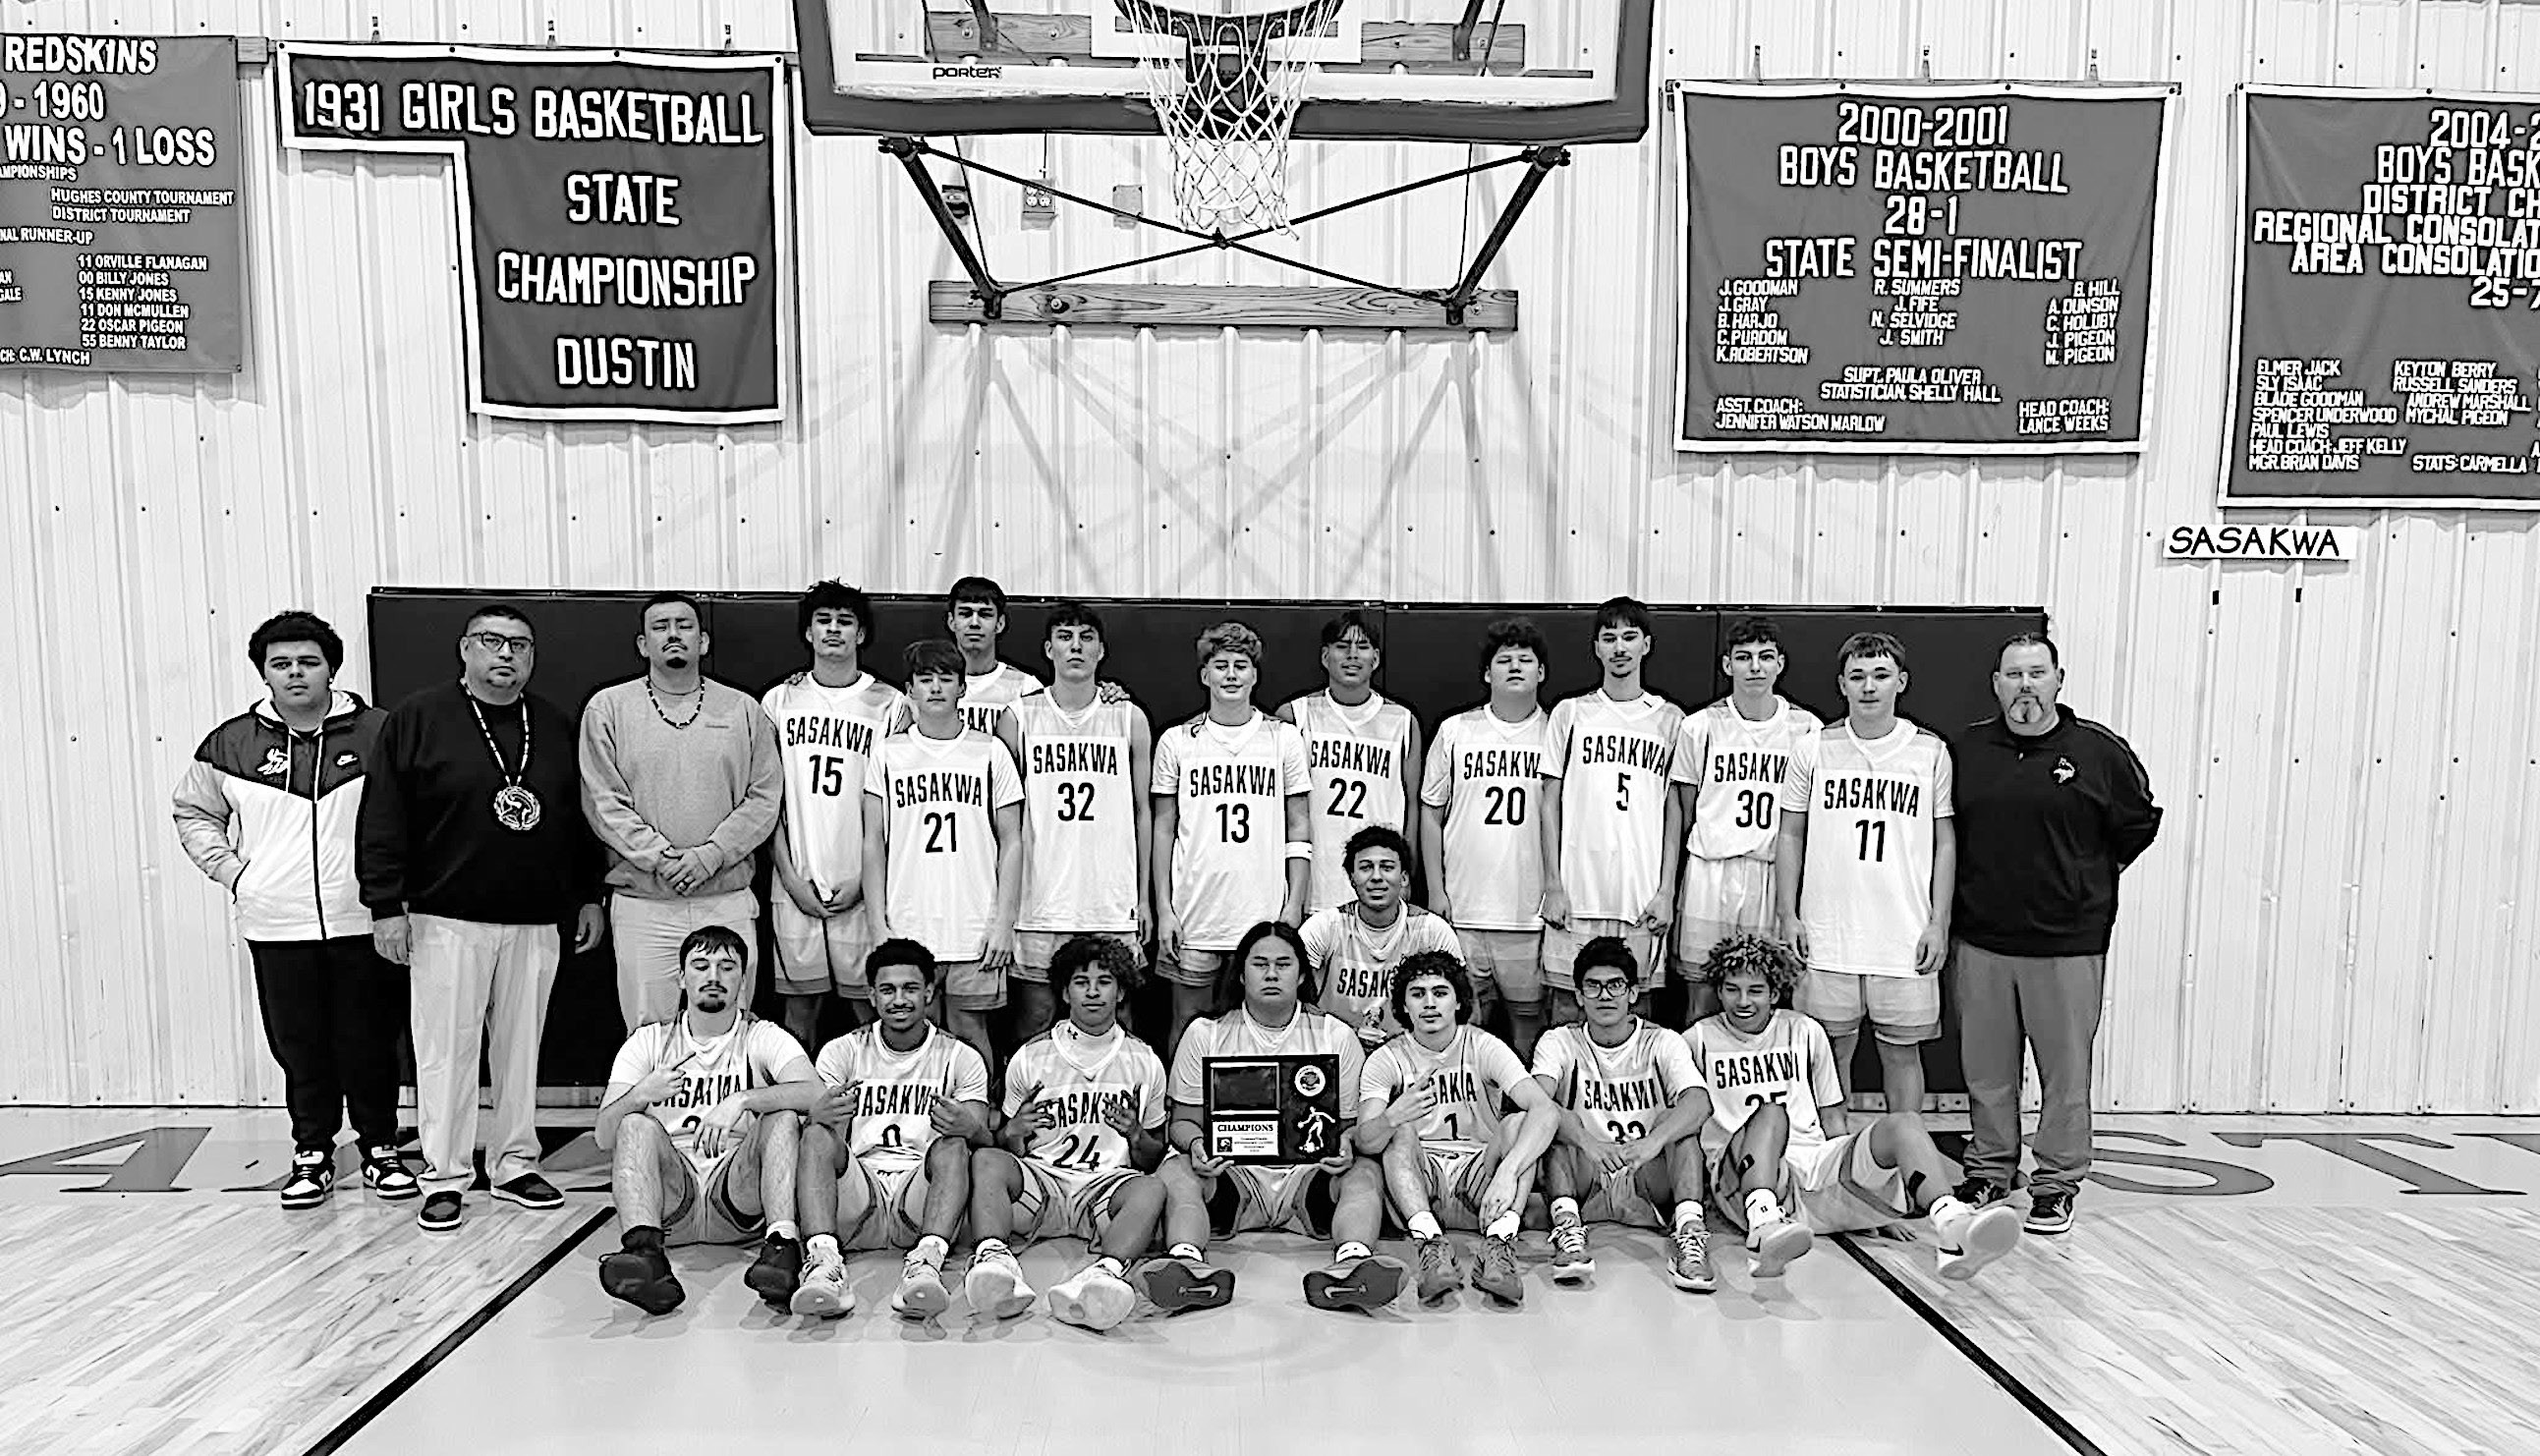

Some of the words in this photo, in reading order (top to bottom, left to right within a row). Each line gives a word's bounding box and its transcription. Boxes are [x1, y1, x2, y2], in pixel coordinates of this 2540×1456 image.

[6, 36, 156, 73] REDSKINS
[34, 82, 103, 119] 1960
[306, 82, 378, 131] 1931
[403, 83, 515, 135] GIRLS
[536, 90, 762, 142] BASKETBALL
[1839, 103, 2006, 146] 2000-2001
[5, 125, 85, 164] WINS
[113, 128, 125, 164] 1
[137, 128, 214, 165] LOSS
[1780, 146, 1856, 185] BOYS
[1875, 149, 2067, 193] BASKETBALL
[2378, 144, 2451, 184] BOYS
[2466, 147, 2540, 190] BASK
[52, 189, 101, 203] HUGHES
[104, 191, 150, 203] COUNTY
[153, 191, 233, 204] TOURNAMENT
[568, 174, 679, 224] STATE
[2364, 185, 2492, 216] DISTRICT
[2509, 188, 2540, 218] CH
[53, 206, 107, 221] DISTRICT
[110, 208, 190, 222] TOURNAMENT
[1886, 196, 1956, 235] 28-1
[21, 228, 92, 244] RUNNER-UP
[2254, 209, 2392, 245] REGIONAL
[2405, 213, 2540, 250] CONSOLAT
[79, 255, 91, 267] 11
[95, 255, 141, 268] ORVILLE
[146, 256, 206, 269] FLANAGAN
[1767, 238, 1854, 277] STATE
[1874, 239, 2081, 279] SEMI-FINALIST
[2291, 242, 2363, 273] AREA
[80, 271, 93, 284] 00
[96, 272, 127, 284] BILLY
[130, 272, 168, 286] JONES
[498, 252, 755, 306] CHAMPIONSHIP
[1875, 279, 1888, 295] R.
[1891, 279, 1960, 295] SUMMERS
[2074, 282, 2085, 297] B.
[2089, 279, 2119, 297] HILL
[80, 287, 93, 301] 15
[96, 288, 135, 301] KENNY
[139, 289, 176, 302] JONES
[1894, 296, 1906, 311] J.
[1909, 296, 1939, 311] FIFE
[2049, 299, 2060, 313] A.
[2062, 297, 2118, 313] DUNSON
[81, 304, 93, 316] 11
[98, 304, 121, 316] DON
[124, 304, 189, 317] MCMULLEN
[1890, 312, 1956, 329] SELVIDGE
[2047, 315, 2060, 331] C.
[2063, 312, 2117, 331] HOLUBY
[82, 318, 95, 331] 22
[98, 318, 136, 332] OSCAR
[140, 319, 183, 333] PIGEON
[1880, 329, 1892, 345] J.
[1900, 329, 1944, 345] SMITH
[83, 334, 96, 347] 55
[99, 334, 138, 348] BENNY
[141, 336, 185, 349] TAYLOR
[2047, 333, 2059, 348] J.
[2063, 328, 2115, 349] PIGEON
[20, 349, 42, 361] C.W.
[46, 349, 89, 364] LYNCH
[558, 338, 695, 388] DUSTIN
[2046, 350, 2059, 364] M.
[2064, 345, 2115, 364] PIGEON
[1886, 367, 1926, 383] PAULA
[1932, 368, 1981, 384] OLIVER
[2258, 360, 2302, 376] ELMER
[2305, 361, 2341, 375] JACK
[2395, 361, 2446, 377] KEYTON
[2452, 362, 2496, 378] BERRY
[1909, 384, 1958, 401] SHELLY
[1964, 386, 2001, 402] HALL
[2256, 375, 2280, 392] SLY
[2284, 375, 2322, 391] ISAAC
[2394, 375, 2455, 392] RUSSELL
[2457, 378, 2516, 394] SANDERS
[1717, 398, 1751, 413] ASST.
[1754, 399, 1802, 415] COACH:
[2019, 401, 2057, 417] HEAD
[2060, 399, 2109, 416] COACH:
[2254, 391, 2298, 407] BLADE
[2300, 391, 2363, 407] GOODMAN
[2407, 393, 2460, 409] ANDREW
[2462, 393, 2531, 413] MARSHALL
[1716, 414, 1777, 429] JENNIFER
[1778, 413, 1829, 429] WATSON
[1831, 416, 1885, 431] MARLOW
[2019, 417, 2060, 433] LANCE
[2064, 415, 2108, 430] WEEKS
[2253, 407, 2313, 424] SPENCER
[2316, 408, 2397, 422] UNDERWOOD
[2406, 407, 2457, 424] MYCHAL
[2461, 409, 2508, 425] PIGEON
[2251, 422, 2284, 438] PAUL
[2286, 422, 2329, 438] LEWIS
[2250, 439, 2283, 454] HEAD
[2367, 438, 2406, 454] KELLY
[2323, 455, 2358, 470] DAVIS
[2460, 456, 2526, 473] CARMELLA
[2170, 527, 2339, 556] SASAKWA
[787, 716, 873, 758] SASAKWA
[1034, 744, 1117, 775] SASAKWA
[1311, 741, 1390, 778] SASAKWA
[1464, 751, 1541, 779] SASAKW
[1583, 736, 1665, 777] SASAKWA
[1715, 753, 1788, 783] SASAKW
[810, 756, 843, 796] 15
[1191, 765, 1274, 797] SASAKWA
[896, 773, 982, 808] SASAKWA
[1058, 783, 1094, 821] 32
[1327, 778, 1366, 818] 22
[1616, 773, 1630, 811] 5
[1825, 778, 1919, 816] SASAKWA
[1485, 787, 1525, 825] 20
[1736, 790, 1774, 829] 30
[925, 812, 956, 853] 21
[1216, 804, 1249, 843] 13
[1856, 820, 1885, 862] 11
[1337, 969, 1391, 997] SASAK
[1444, 1113, 1459, 1140] 1
[1052, 1135, 1100, 1171] 24
